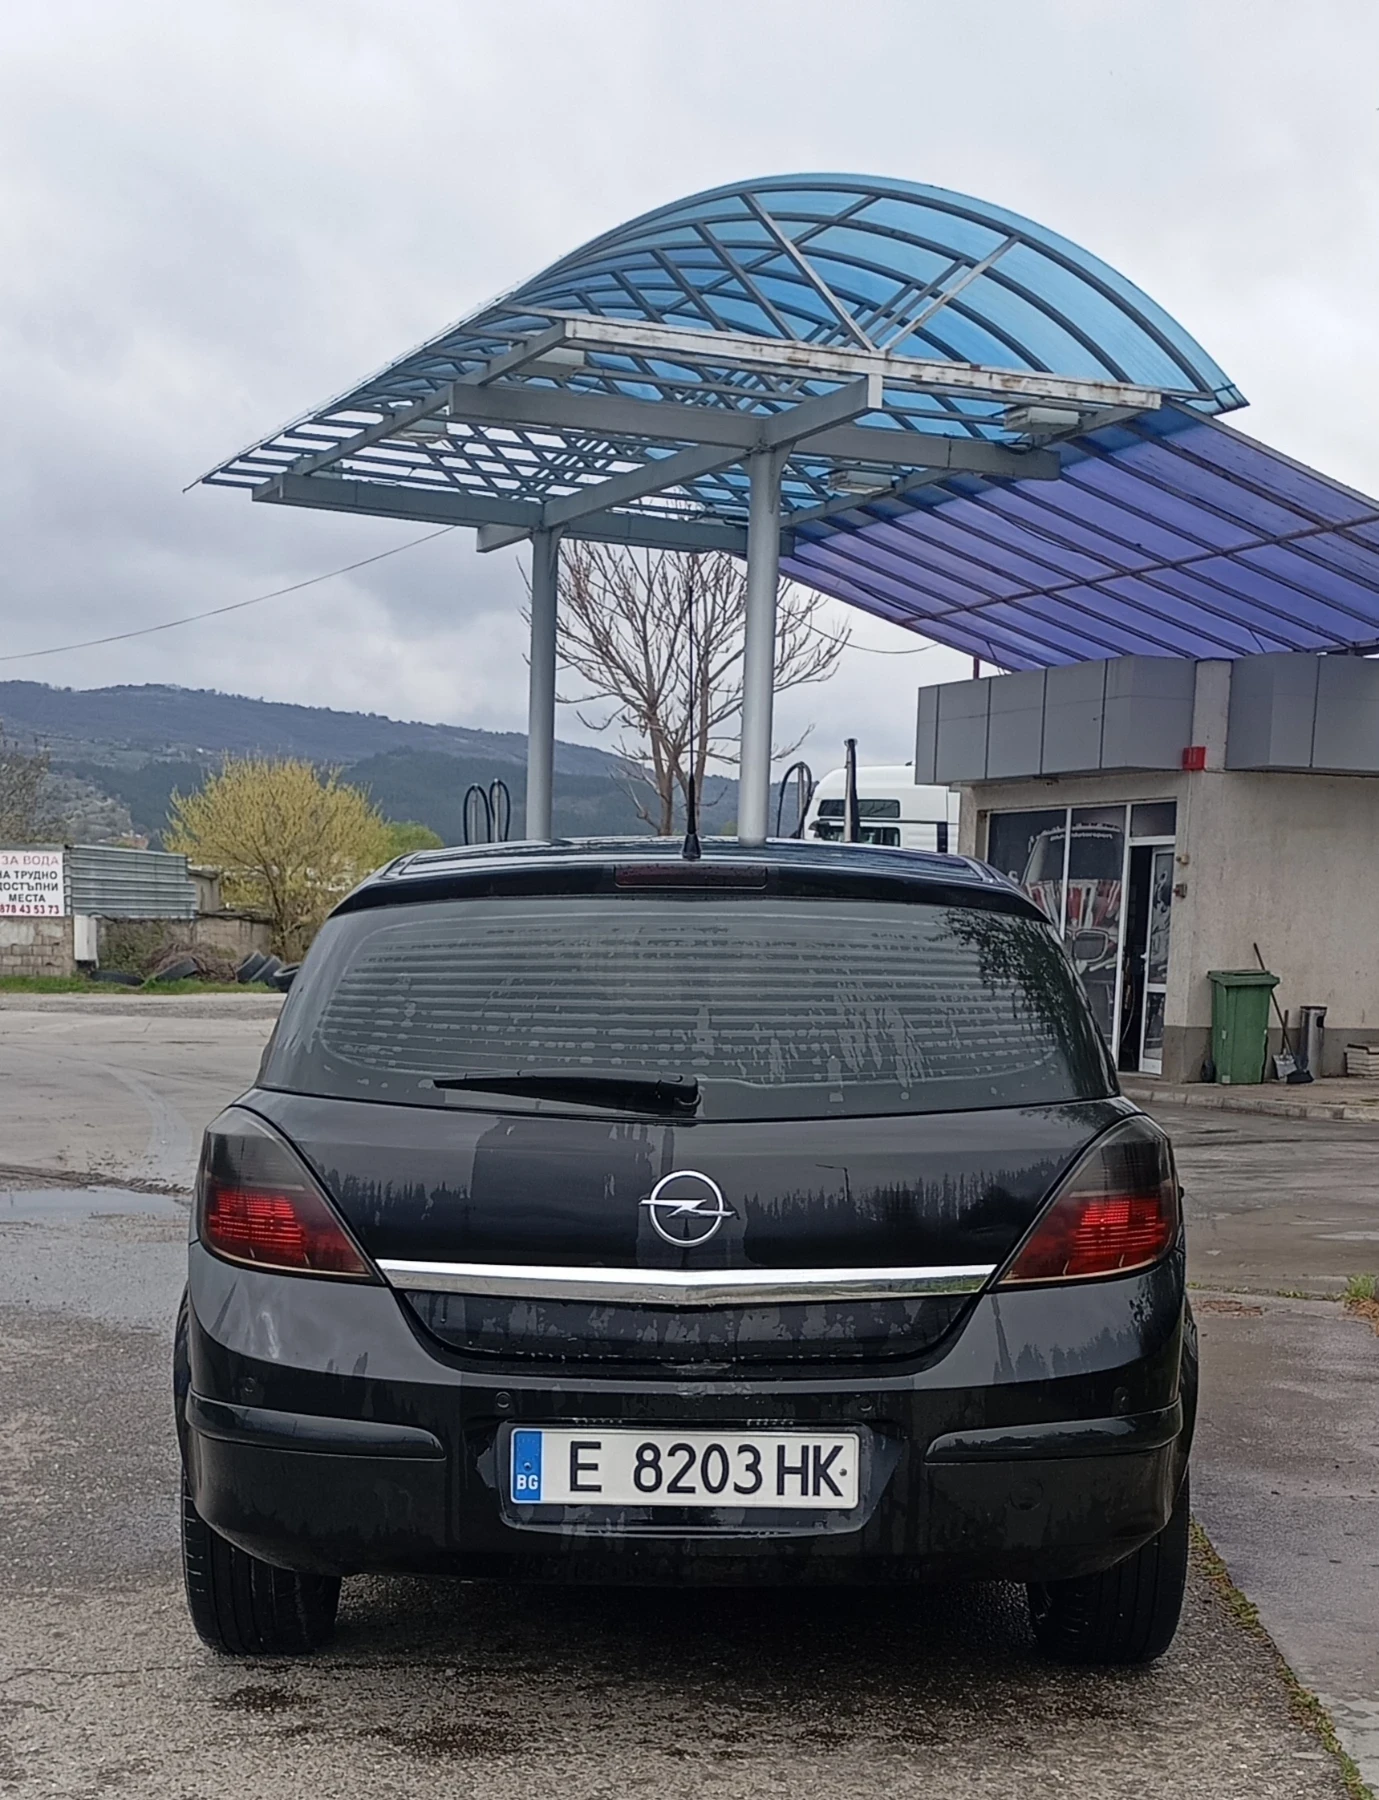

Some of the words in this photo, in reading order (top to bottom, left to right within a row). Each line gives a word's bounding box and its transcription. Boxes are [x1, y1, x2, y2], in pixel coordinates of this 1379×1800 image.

[2, 855, 19, 865] ЗА
[23, 855, 60, 866] ВОДА
[14, 870, 58, 880] ТРУДНО
[9, 893, 46, 903] МЕСТА
[19, 904, 31, 914] 43
[34, 904, 46, 914] 53
[48, 904, 60, 915] 73
[569, 1440, 602, 1493] E
[633, 1441, 763, 1495] 8203
[776, 1444, 844, 1497] HK
[516, 1474, 539, 1491] BG
